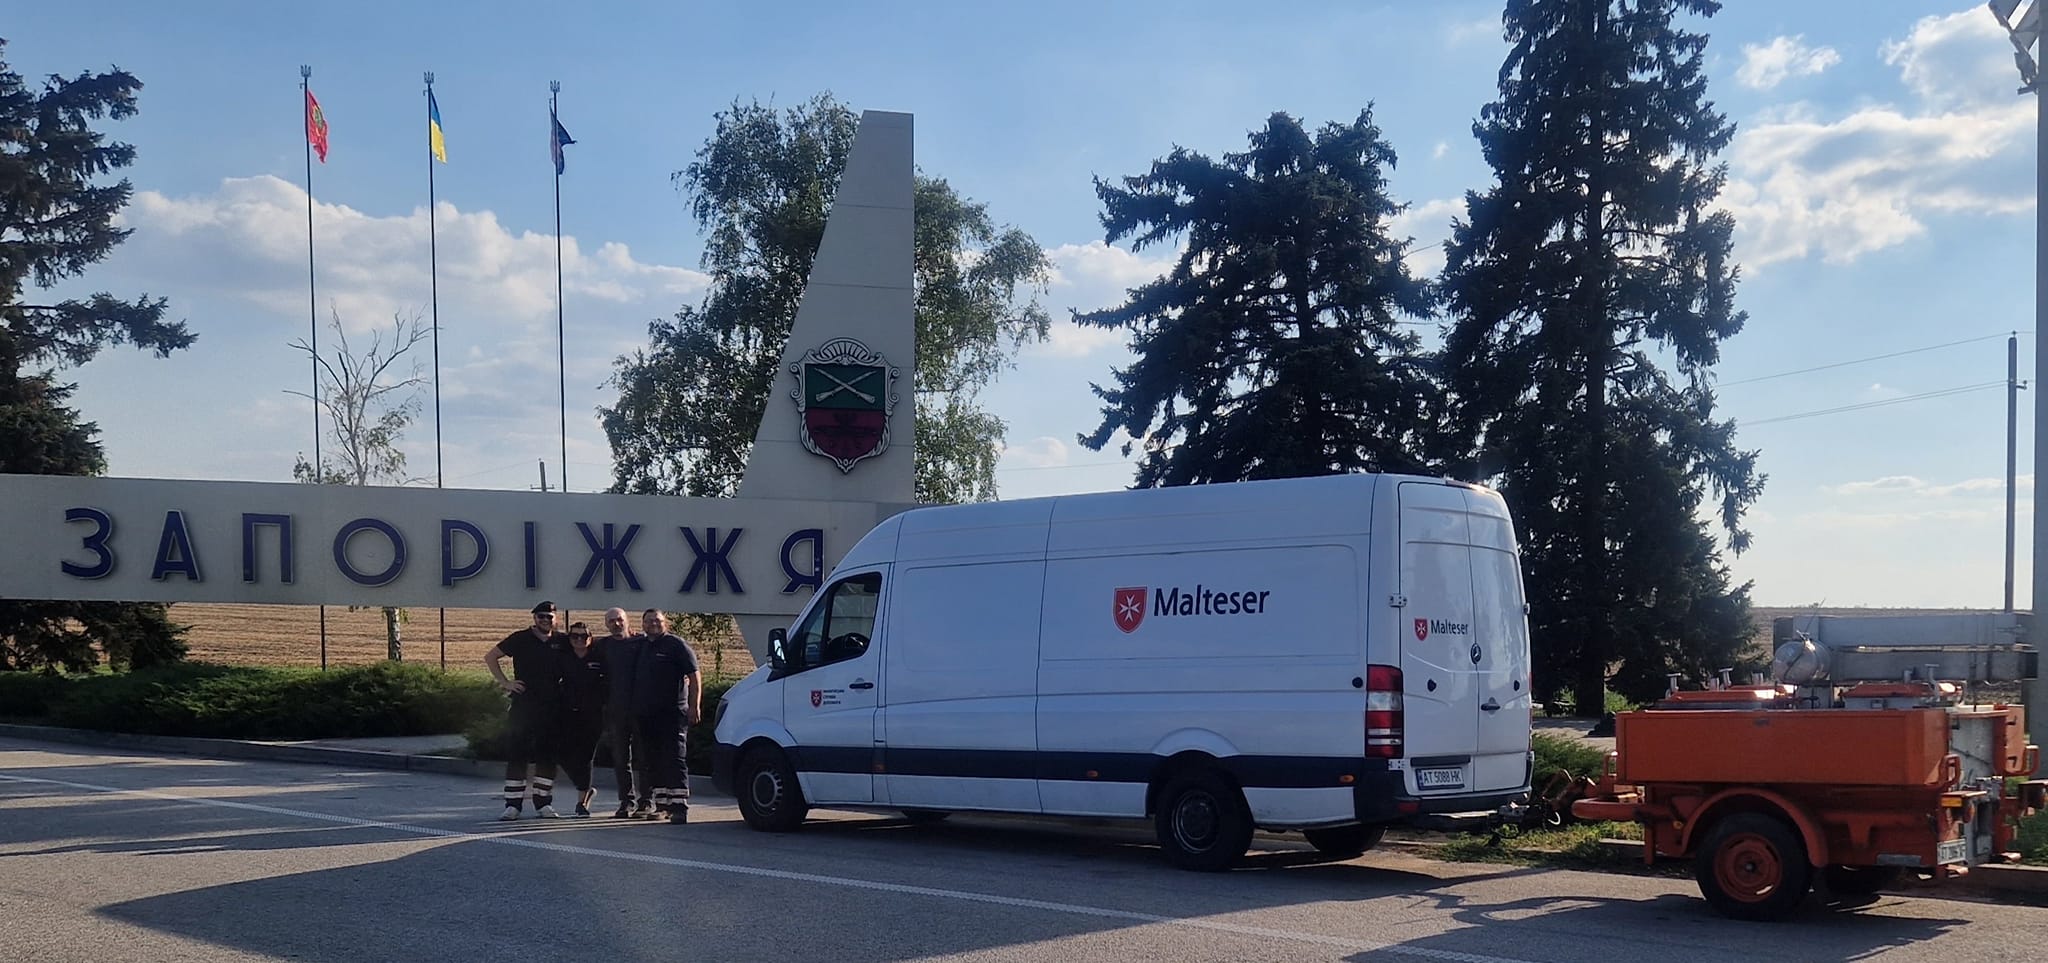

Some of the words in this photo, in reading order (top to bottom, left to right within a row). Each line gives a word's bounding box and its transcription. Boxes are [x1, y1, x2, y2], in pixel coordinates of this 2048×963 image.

[60, 506, 825, 595] ЗАПОРІЖЖЯ
[1153, 584, 1270, 617] Malteser
[1430, 618, 1468, 635] Malteser
